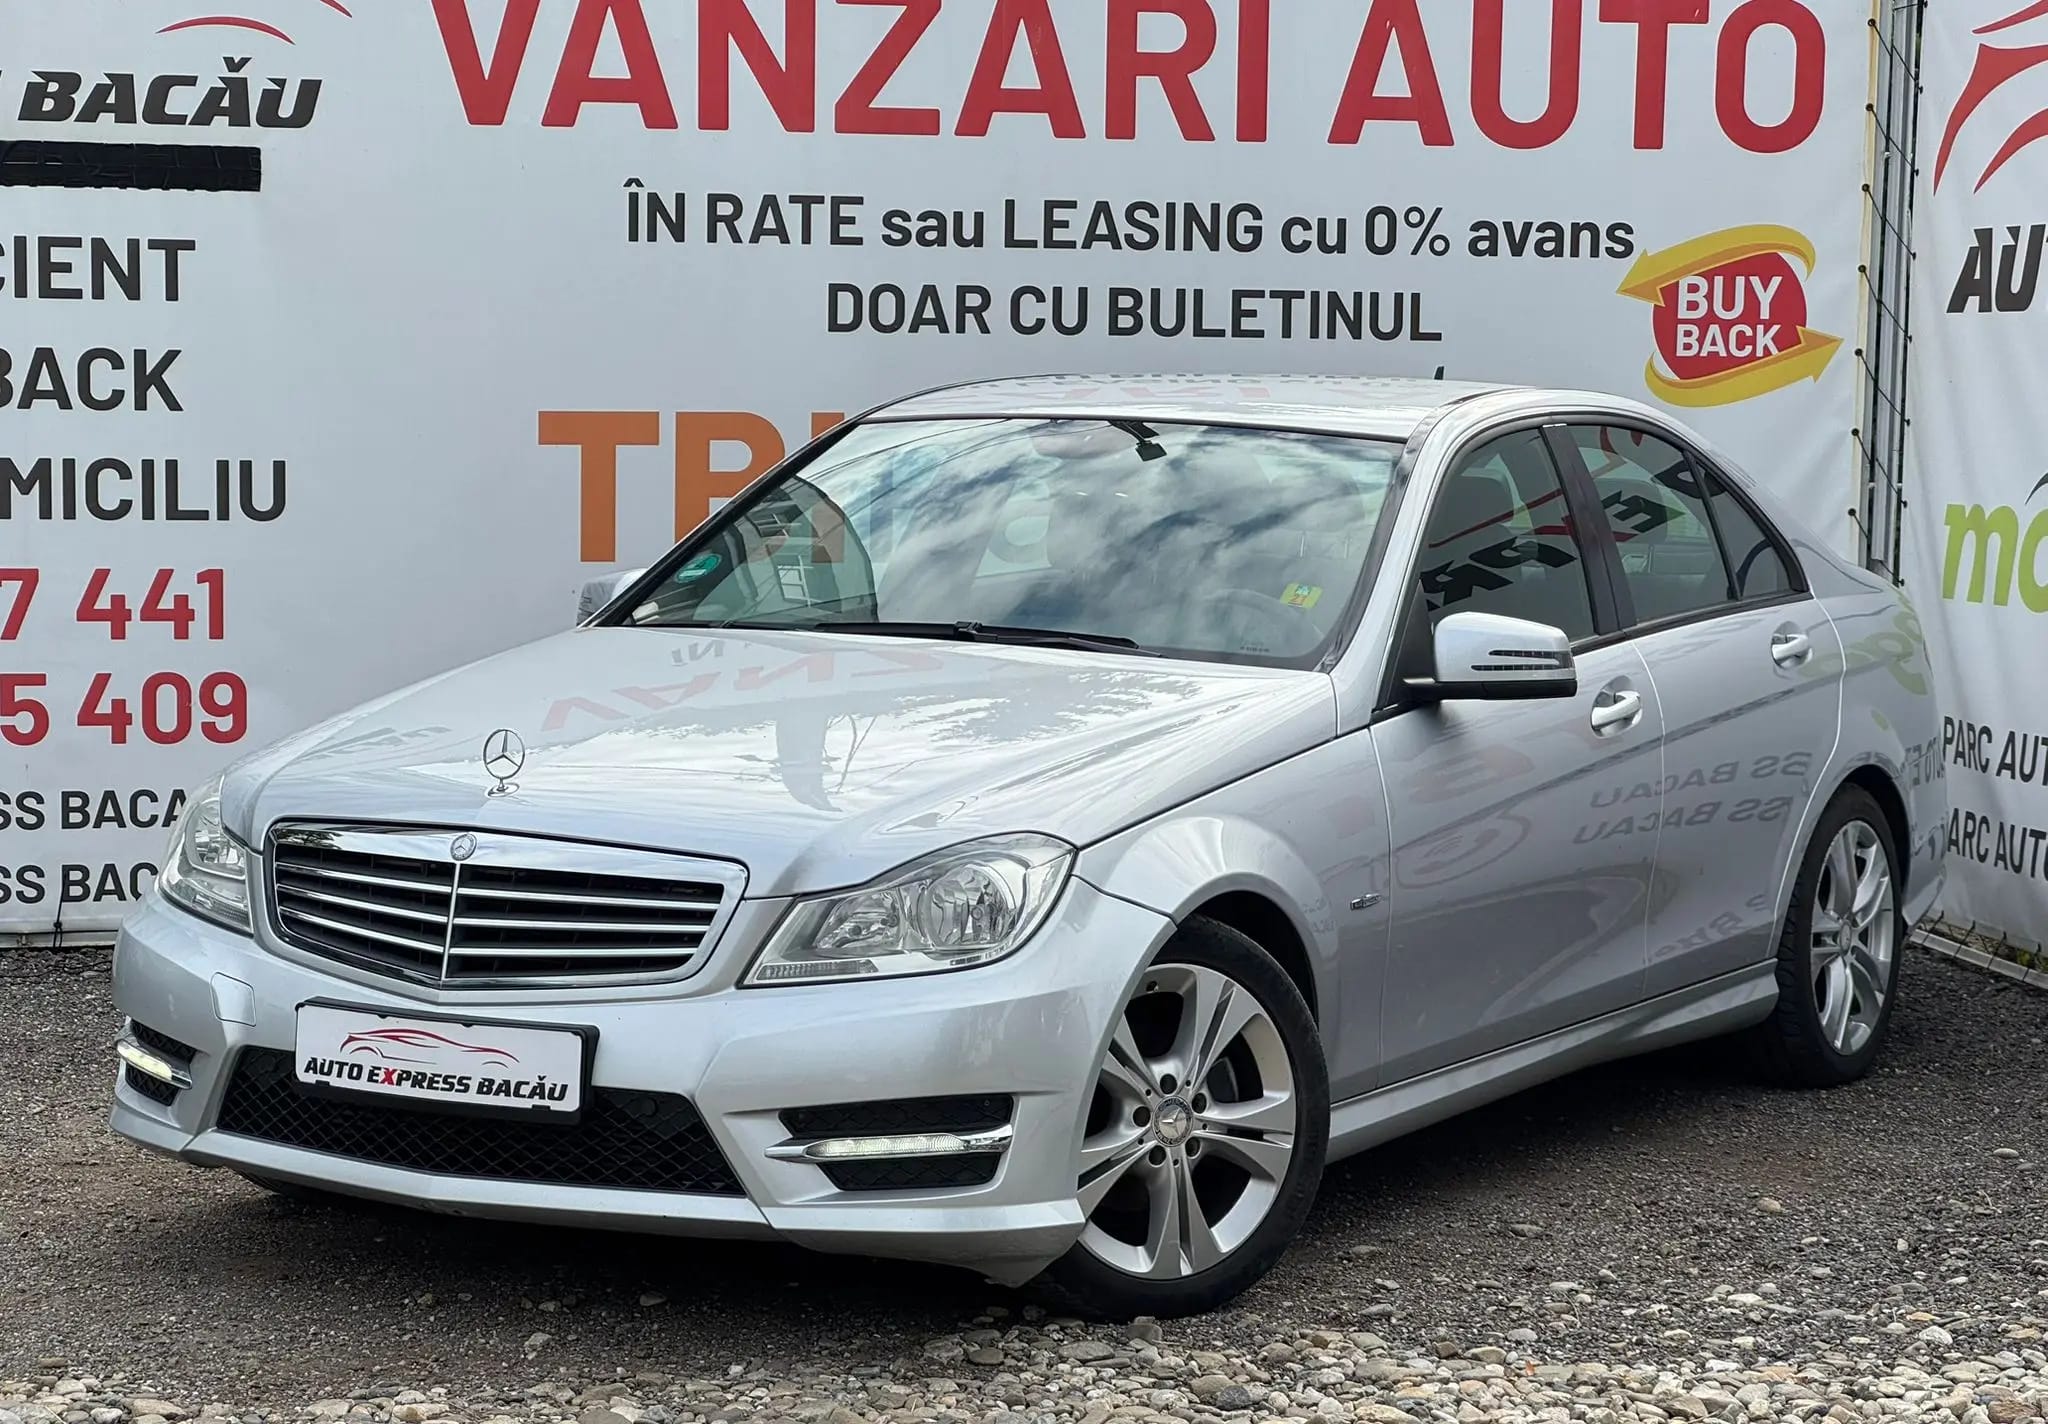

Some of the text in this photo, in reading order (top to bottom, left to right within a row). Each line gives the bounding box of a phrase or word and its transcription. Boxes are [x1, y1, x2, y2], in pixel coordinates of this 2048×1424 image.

[17, 56, 323, 129] BACĂU
[1329, 0, 1826, 154] AUTO
[623, 177, 1634, 259] ÎN RATE sau LEASING cu 0% avans
[0, 235, 196, 302] IENT
[1677, 275, 1783, 320] BUY
[827, 282, 1443, 342] DOAR CU BULETINUL
[1675, 323, 1781, 357] BACK
[0, 457, 286, 522] MICILIU
[0, 568, 224, 641] 7 441
[0, 671, 247, 746] 5 409
[1942, 715, 1993, 774] PARC
[1947, 807, 1991, 864] ARC
[1993, 820, 2048, 882] AUT
[303, 1057, 569, 1102] AUTO EXPRESS BACĂU
